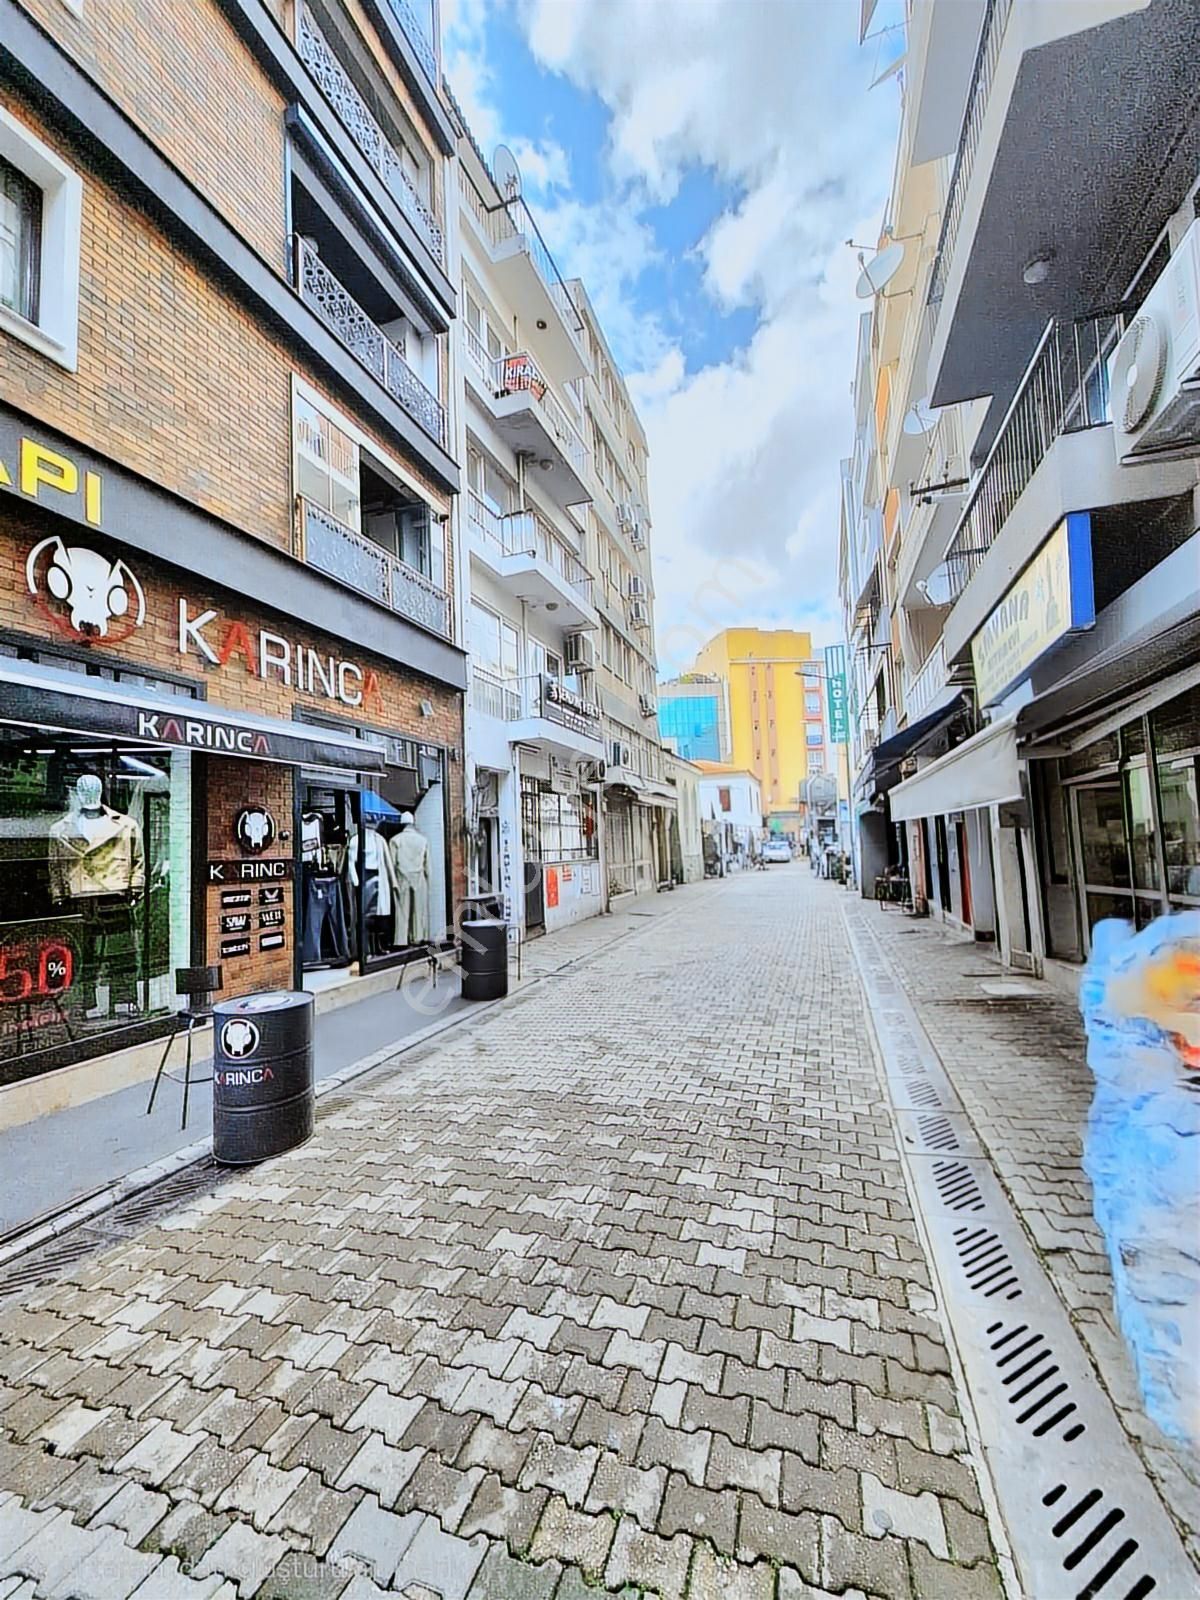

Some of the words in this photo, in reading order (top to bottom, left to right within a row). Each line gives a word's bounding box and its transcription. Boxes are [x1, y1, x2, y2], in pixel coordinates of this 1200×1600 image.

[178, 597, 385, 714] KARINCA
[832, 678, 843, 731] HOTEL
[138, 712, 271, 754] KARINCA
